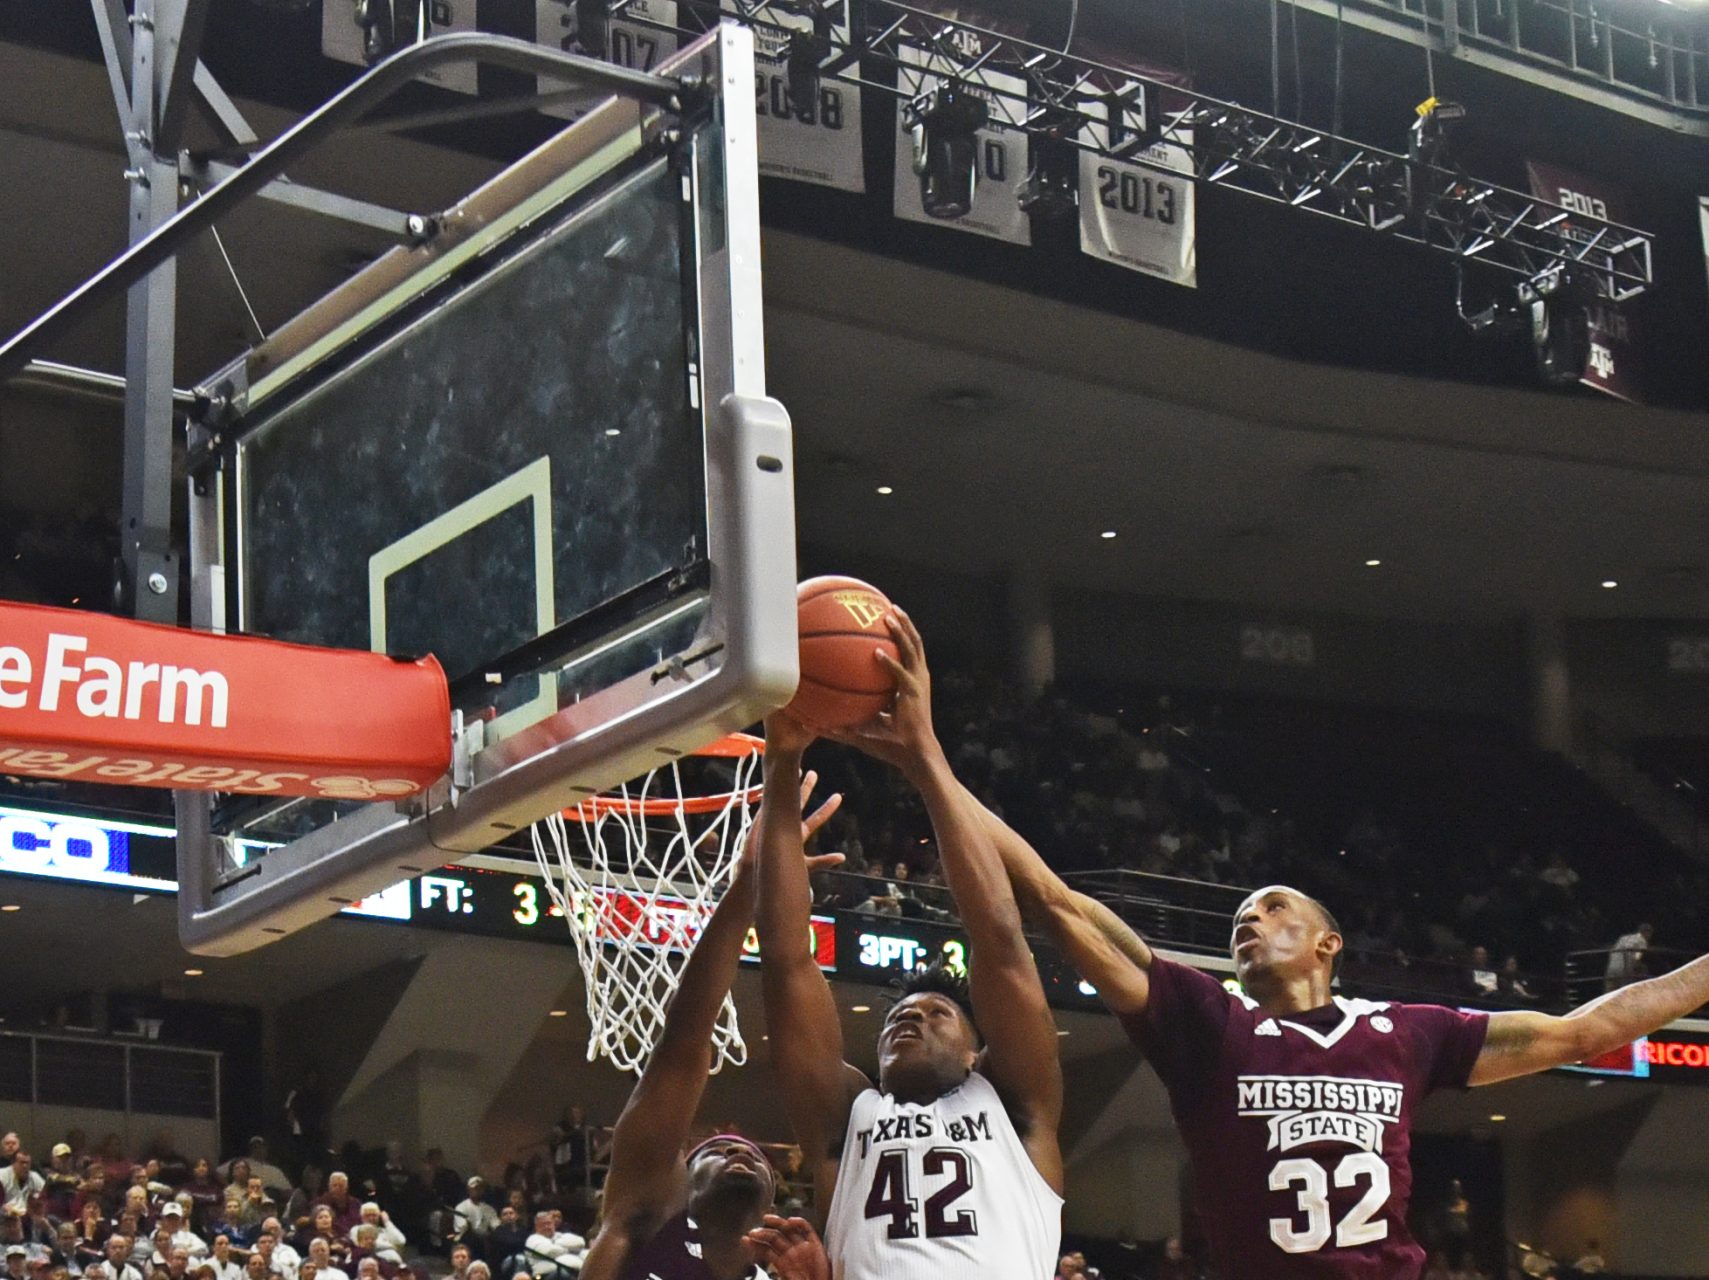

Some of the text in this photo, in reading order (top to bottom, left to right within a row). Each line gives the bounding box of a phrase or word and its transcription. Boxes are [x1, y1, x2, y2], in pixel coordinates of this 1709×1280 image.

[1098, 165, 1175, 225] 2013
[420, 876, 474, 914] FT:
[859, 933, 927, 972] 3PT:
[857, 1114, 932, 1160] TXAS
[1289, 1116, 1368, 1143] STATE
[864, 1146, 978, 1240] 42
[1268, 1151, 1391, 1254] 32
